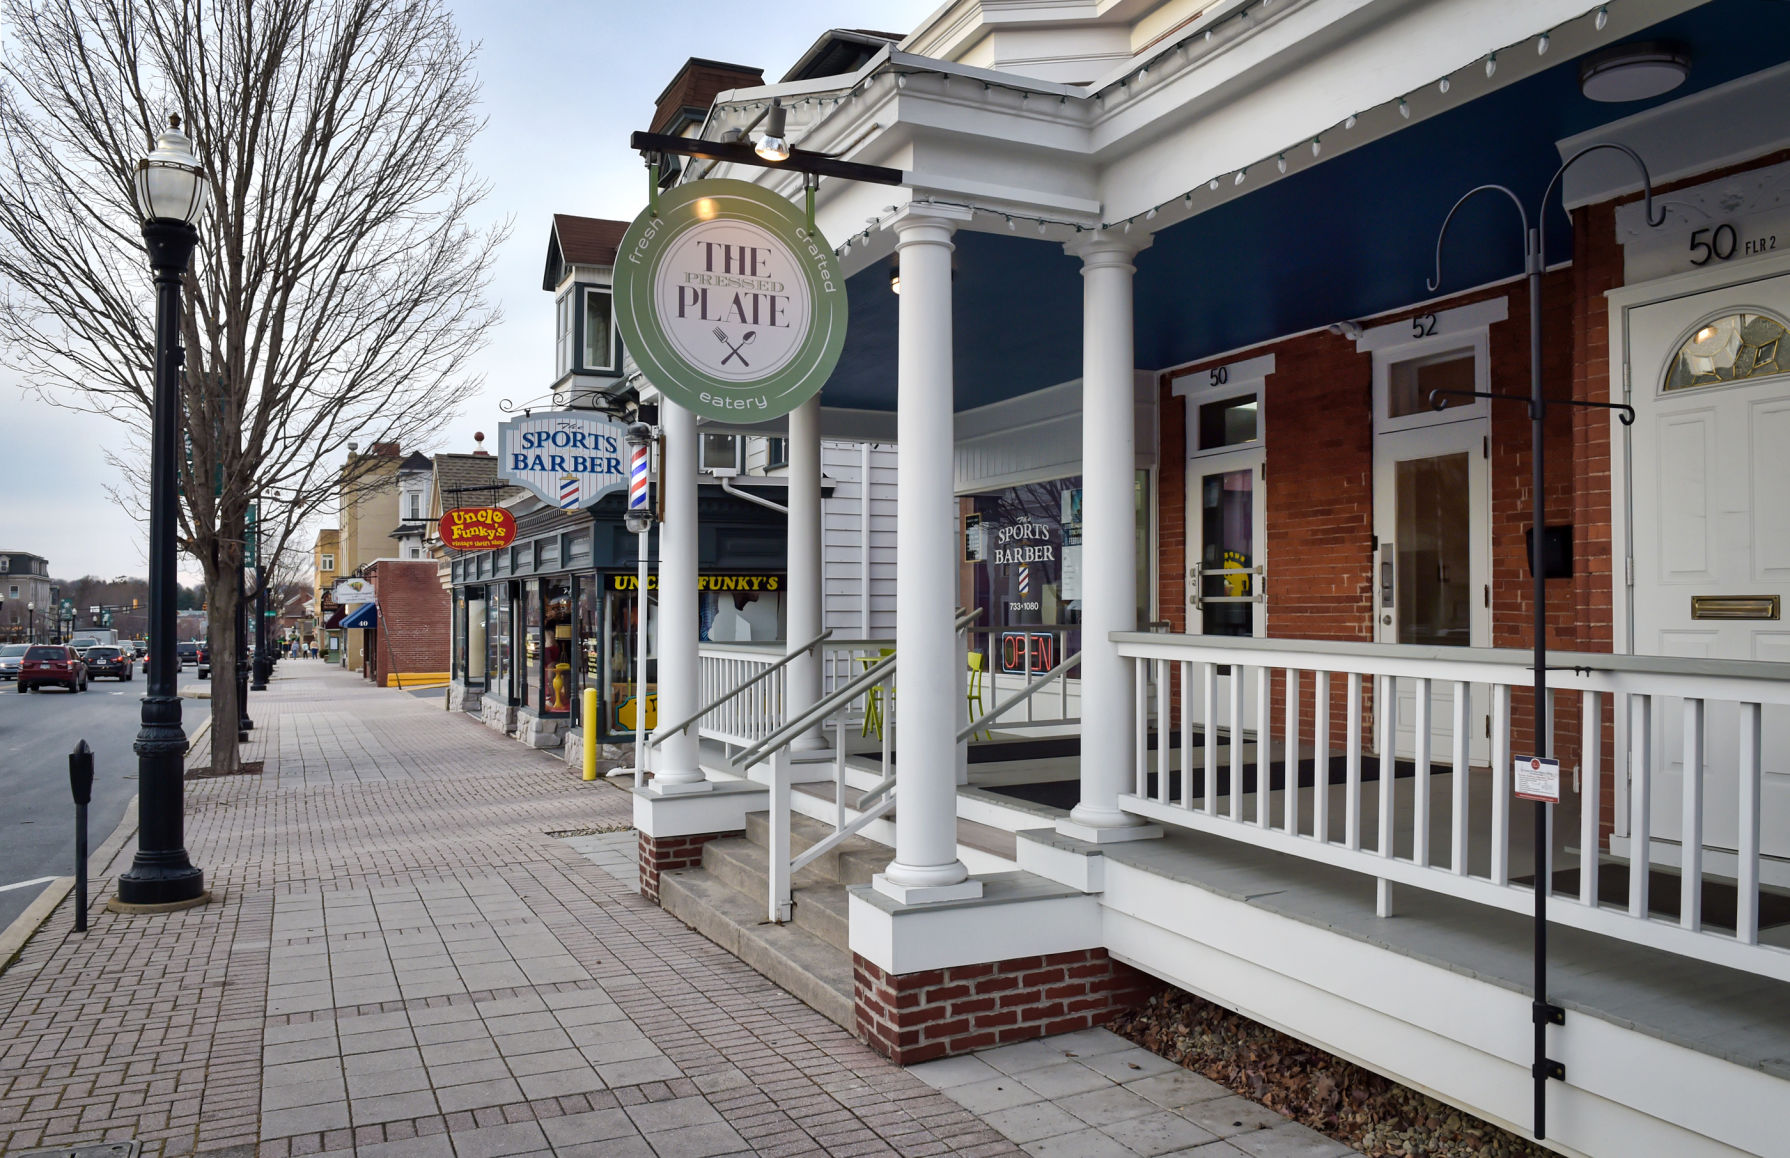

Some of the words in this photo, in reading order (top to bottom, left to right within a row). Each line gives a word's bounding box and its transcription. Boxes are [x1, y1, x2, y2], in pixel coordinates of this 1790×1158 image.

[629, 218, 665, 265] fresh
[1690, 223, 1738, 266] 50
[1745, 238, 1766, 255] FLR
[1769, 235, 1777, 249] 2
[697, 240, 772, 278] THE
[683, 271, 785, 293] PRESSED
[676, 285, 790, 328] PLATE
[1411, 313, 1439, 339] 52
[1210, 366, 1228, 387] 50
[699, 391, 768, 410] eatery
[522, 430, 618, 454] SPORTS
[511, 453, 625, 475] BARBER
[451, 509, 504, 524] Uncle
[451, 523, 506, 540] Funky's
[998, 523, 1050, 544] SPORTS
[994, 545, 1055, 564] BARBER
[698, 576, 778, 590] FUNKY'S
[1005, 636, 1051, 671] OPEN
